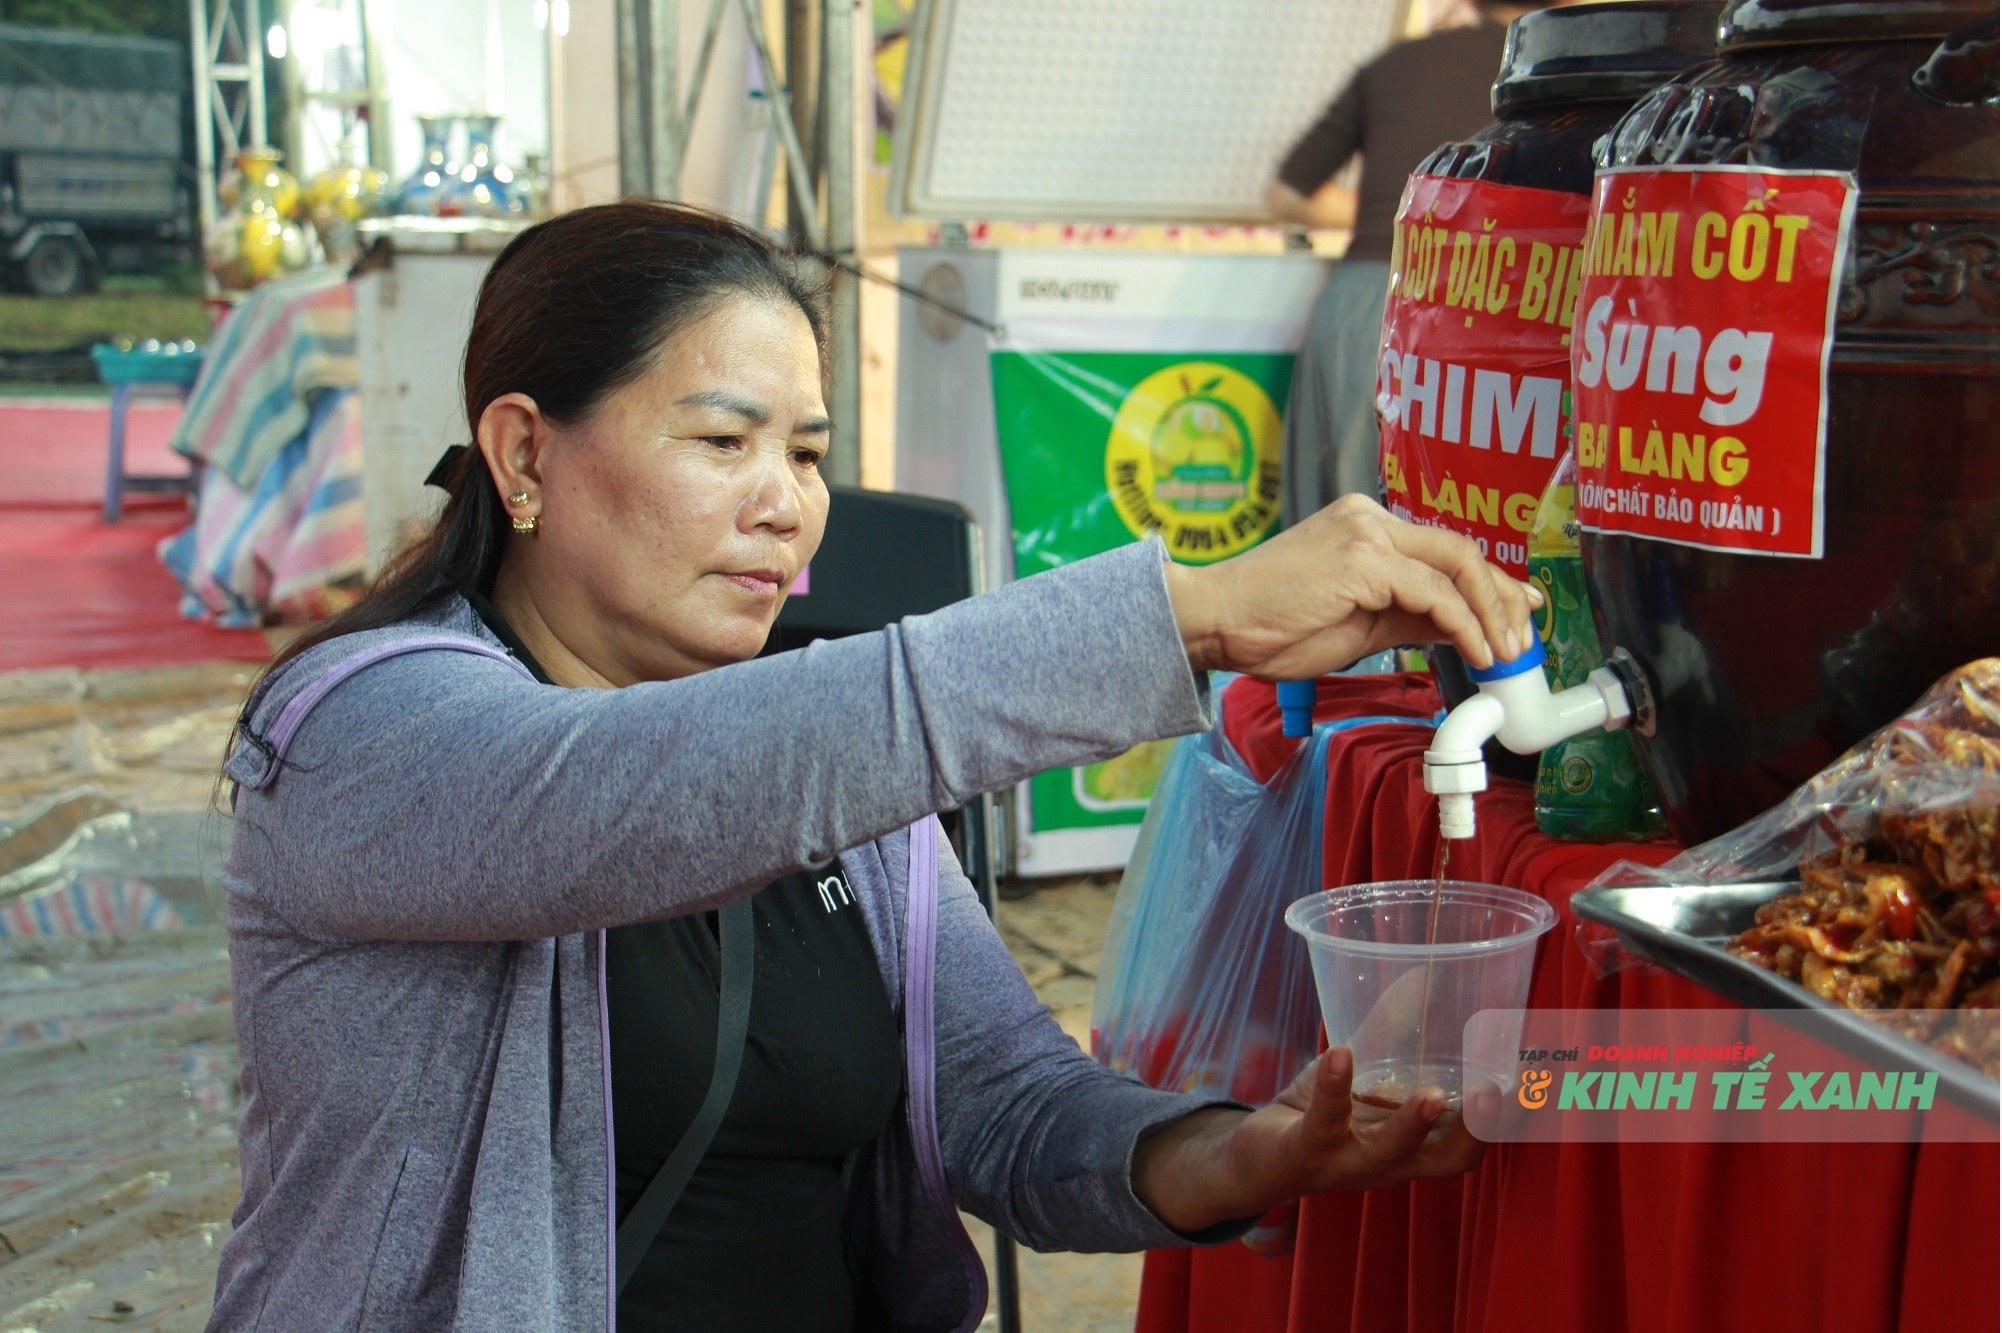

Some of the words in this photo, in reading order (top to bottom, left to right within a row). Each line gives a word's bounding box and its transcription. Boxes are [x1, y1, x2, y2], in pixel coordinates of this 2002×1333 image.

[1403, 200, 1449, 303] CỐT
[1445, 217, 1516, 329] ĐẶC
[1518, 232, 1588, 345] BIỆ
[1691, 189, 1809, 283] CỐT
[1376, 347, 1563, 460] CHIM
[1578, 295, 1774, 425] Sùng
[1384, 452, 1408, 493] BA
[1420, 470, 1540, 533] LÀNG
[1578, 422, 1608, 469] BA
[1618, 420, 1749, 487] LÀNG
[1654, 488, 1692, 523] BẢO
[1700, 495, 1764, 532] QUẢN
